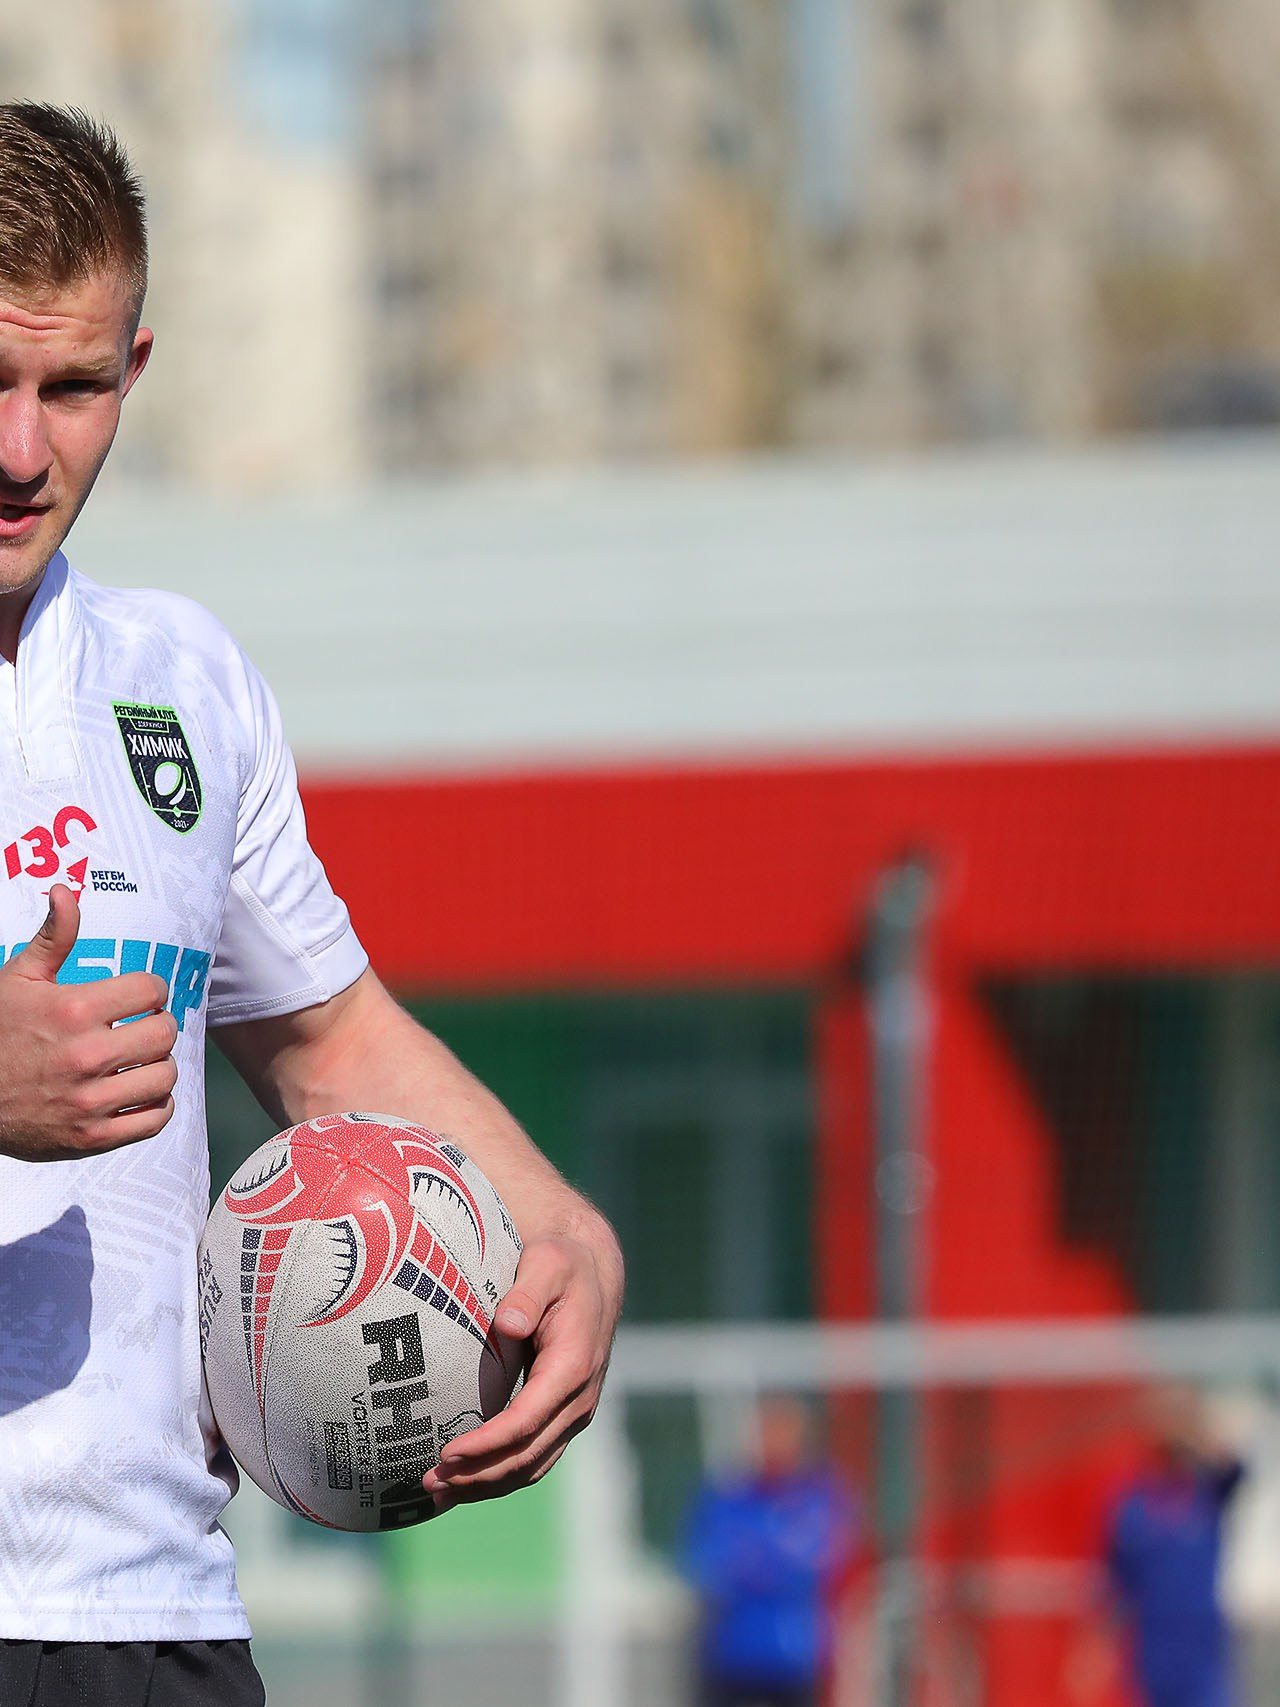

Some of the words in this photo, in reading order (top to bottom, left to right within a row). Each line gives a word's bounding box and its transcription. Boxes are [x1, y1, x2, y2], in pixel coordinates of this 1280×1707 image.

[113, 704, 159, 719] РЕГБИЙНЫЙ
[126, 733, 189, 760] ХИМИК
[90, 870, 126, 881] РЕГБИ
[92, 881, 138, 893] РОССИИ
[351, 1389, 373, 1467] VORTEX
[358, 1473, 375, 1508] ELITE
